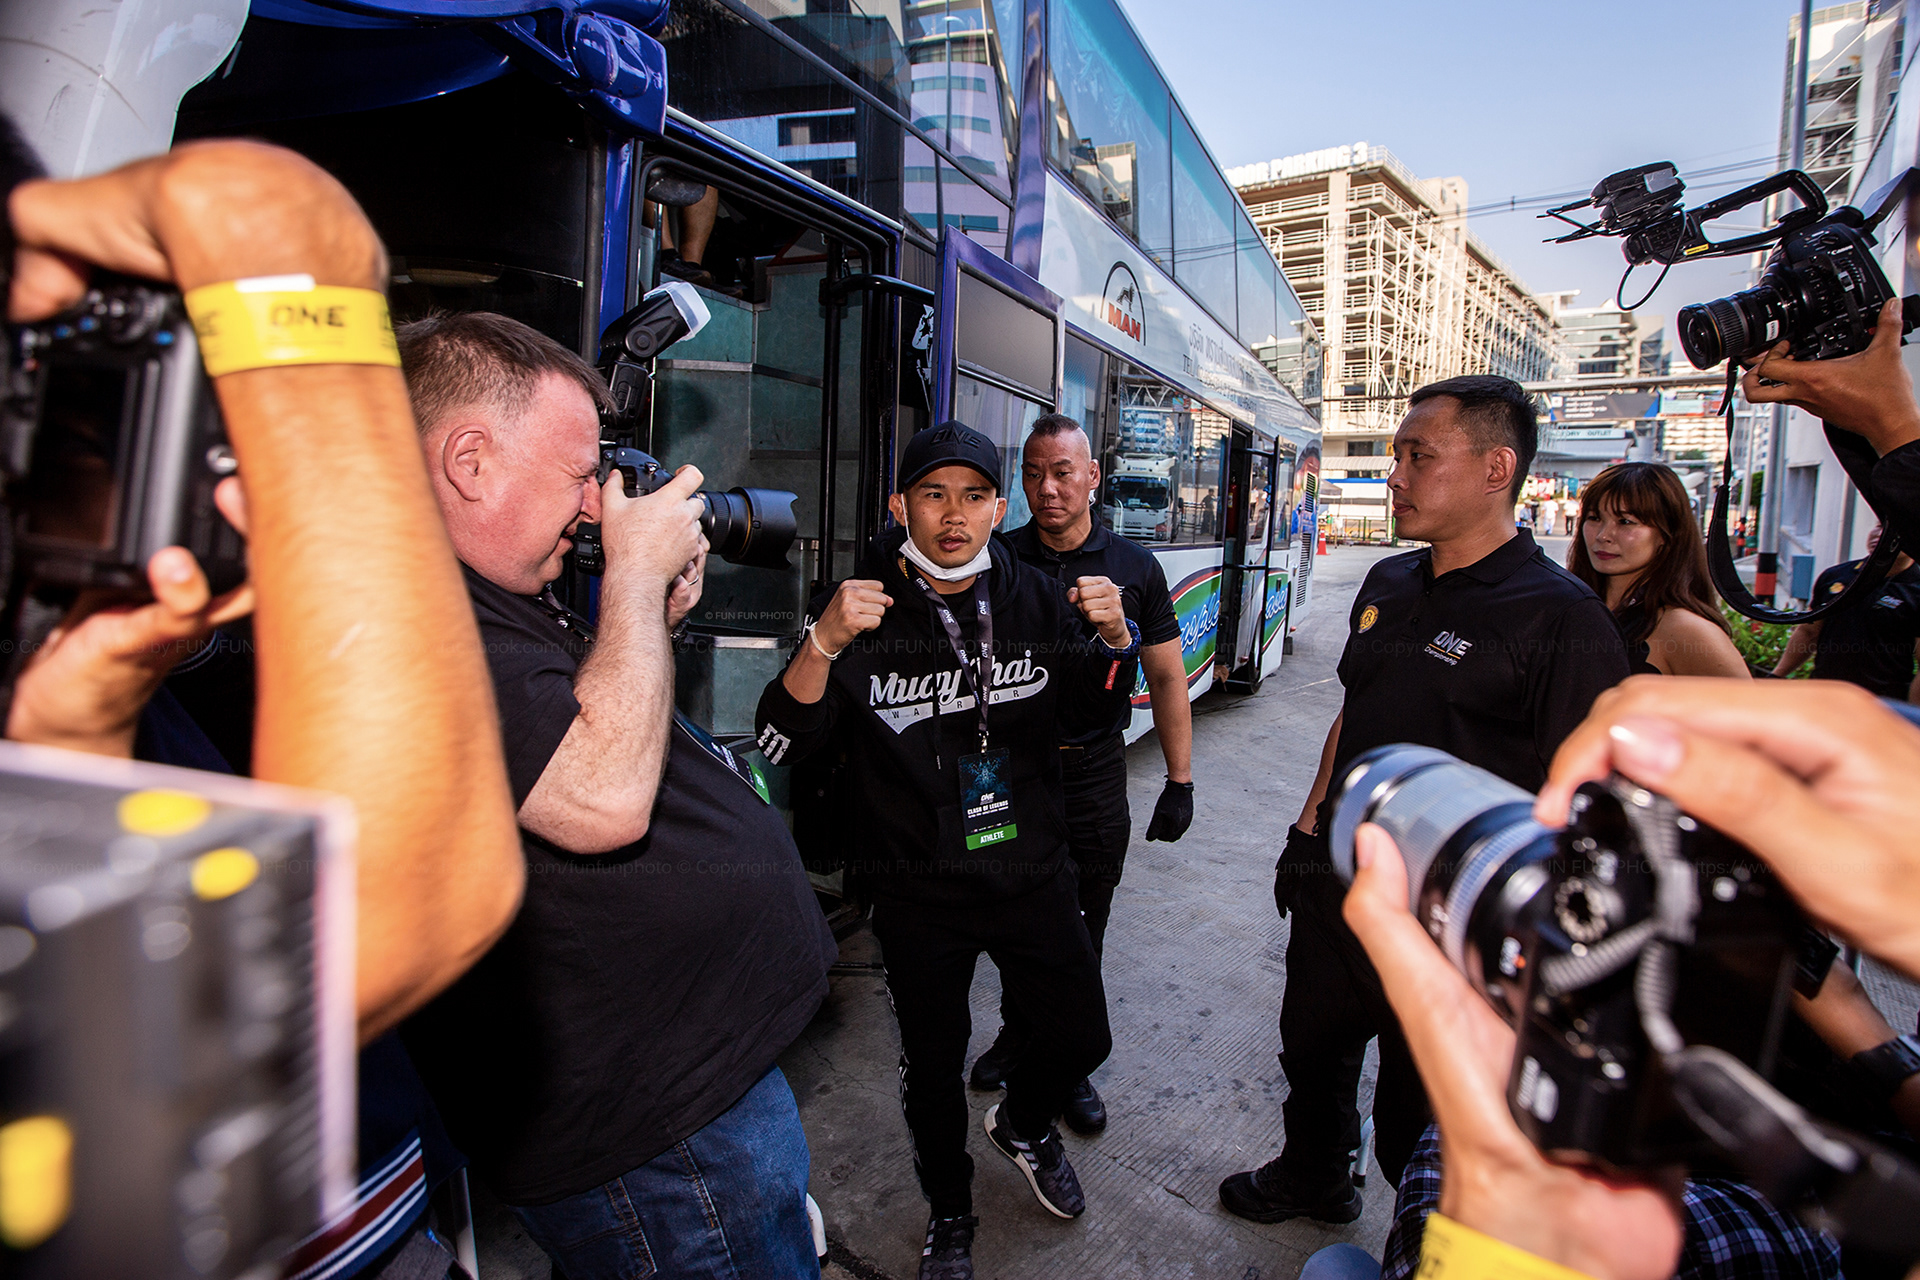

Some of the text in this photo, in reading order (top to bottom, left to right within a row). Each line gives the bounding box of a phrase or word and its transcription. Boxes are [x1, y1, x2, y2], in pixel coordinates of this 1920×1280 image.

[1270, 145, 1350, 180] PARKING
[1353, 141, 1368, 164] 3
[268, 303, 348, 328] ONE
[1108, 302, 1141, 342] MAN
[930, 425, 982, 449] ONE
[943, 609, 955, 624] ONE
[979, 600, 987, 615] ONE
[1433, 630, 1473, 656] ONE
[959, 649, 969, 664] ONE
[869, 670, 963, 707] Muay
[980, 831, 1005, 844] ATHLETE
